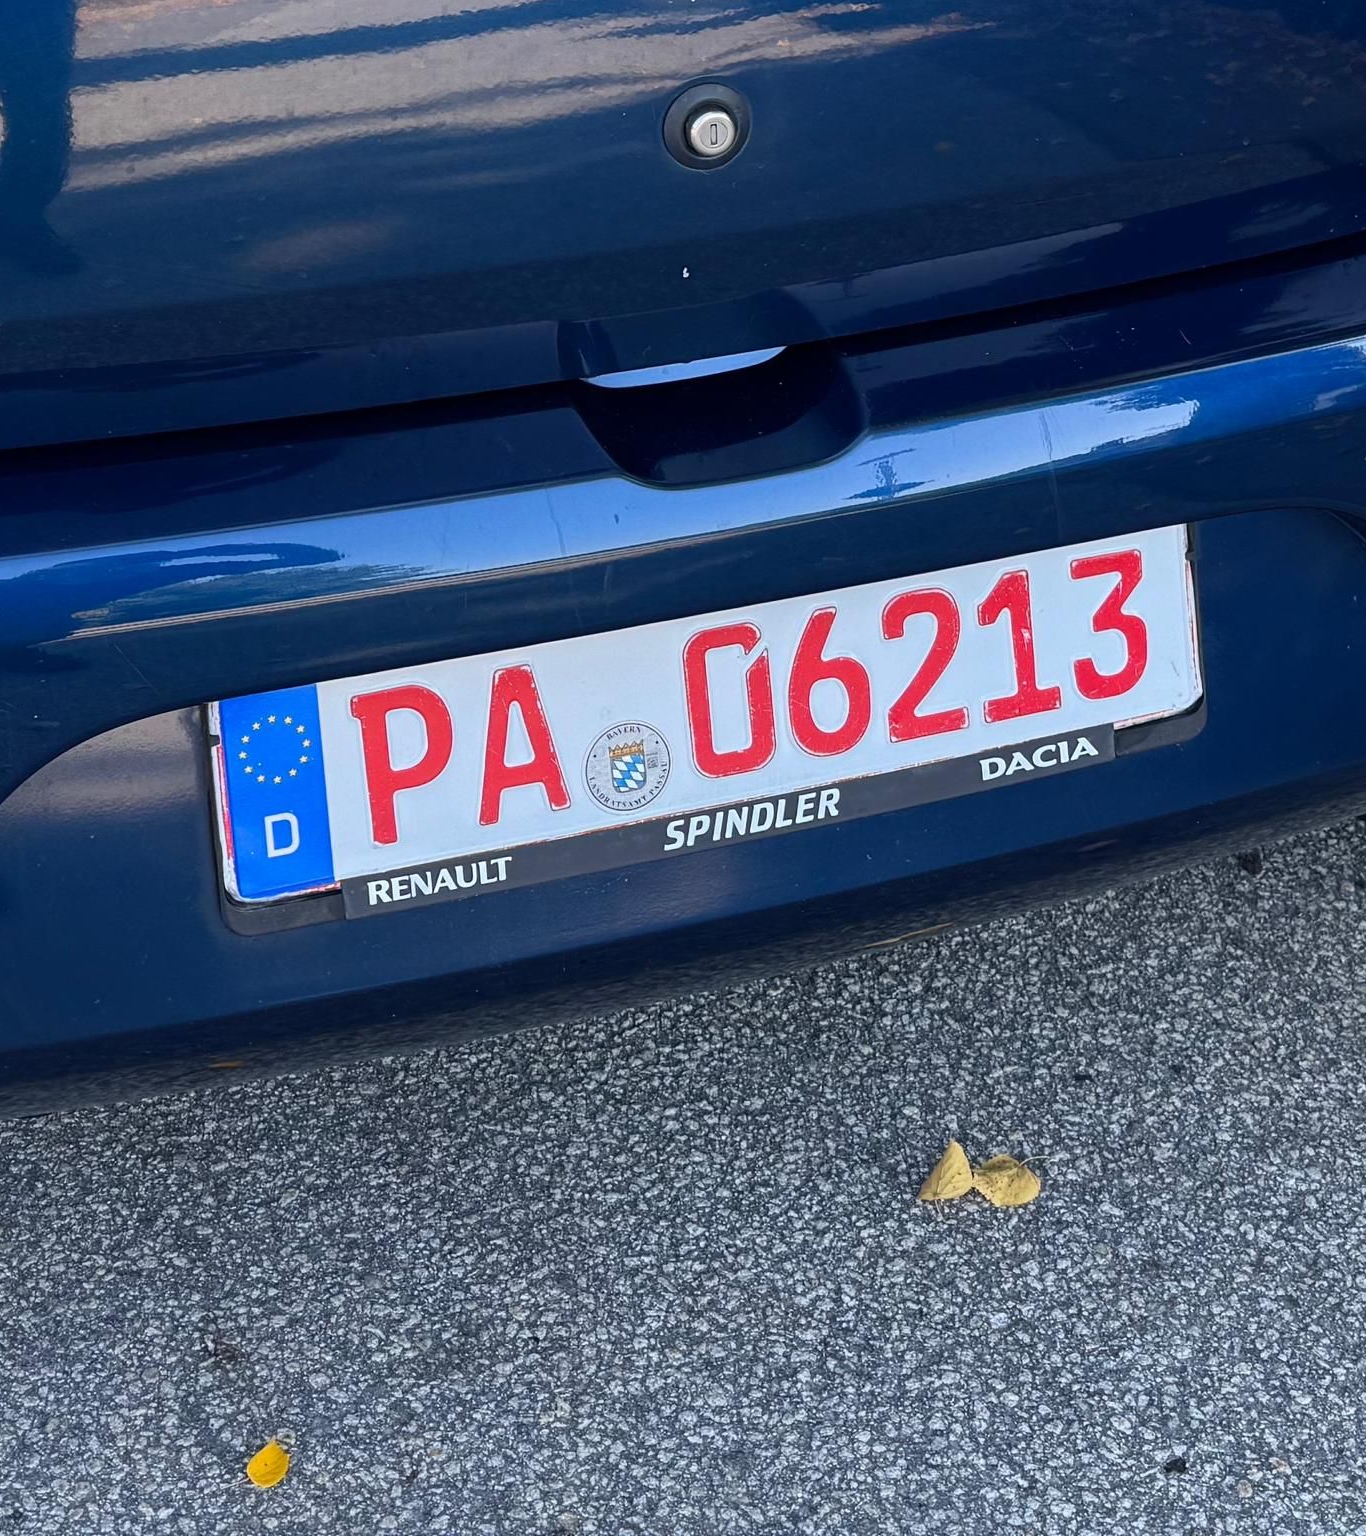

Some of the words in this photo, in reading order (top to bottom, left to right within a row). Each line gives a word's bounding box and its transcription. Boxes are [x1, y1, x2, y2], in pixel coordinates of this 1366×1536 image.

[350, 663, 571, 846] PA
[682, 548, 1149, 780] 06213
[979, 736, 1100, 781] DACIA
[264, 810, 300, 859] D
[663, 786, 841, 851] SPINDLER
[367, 855, 512, 906] RENAULT
